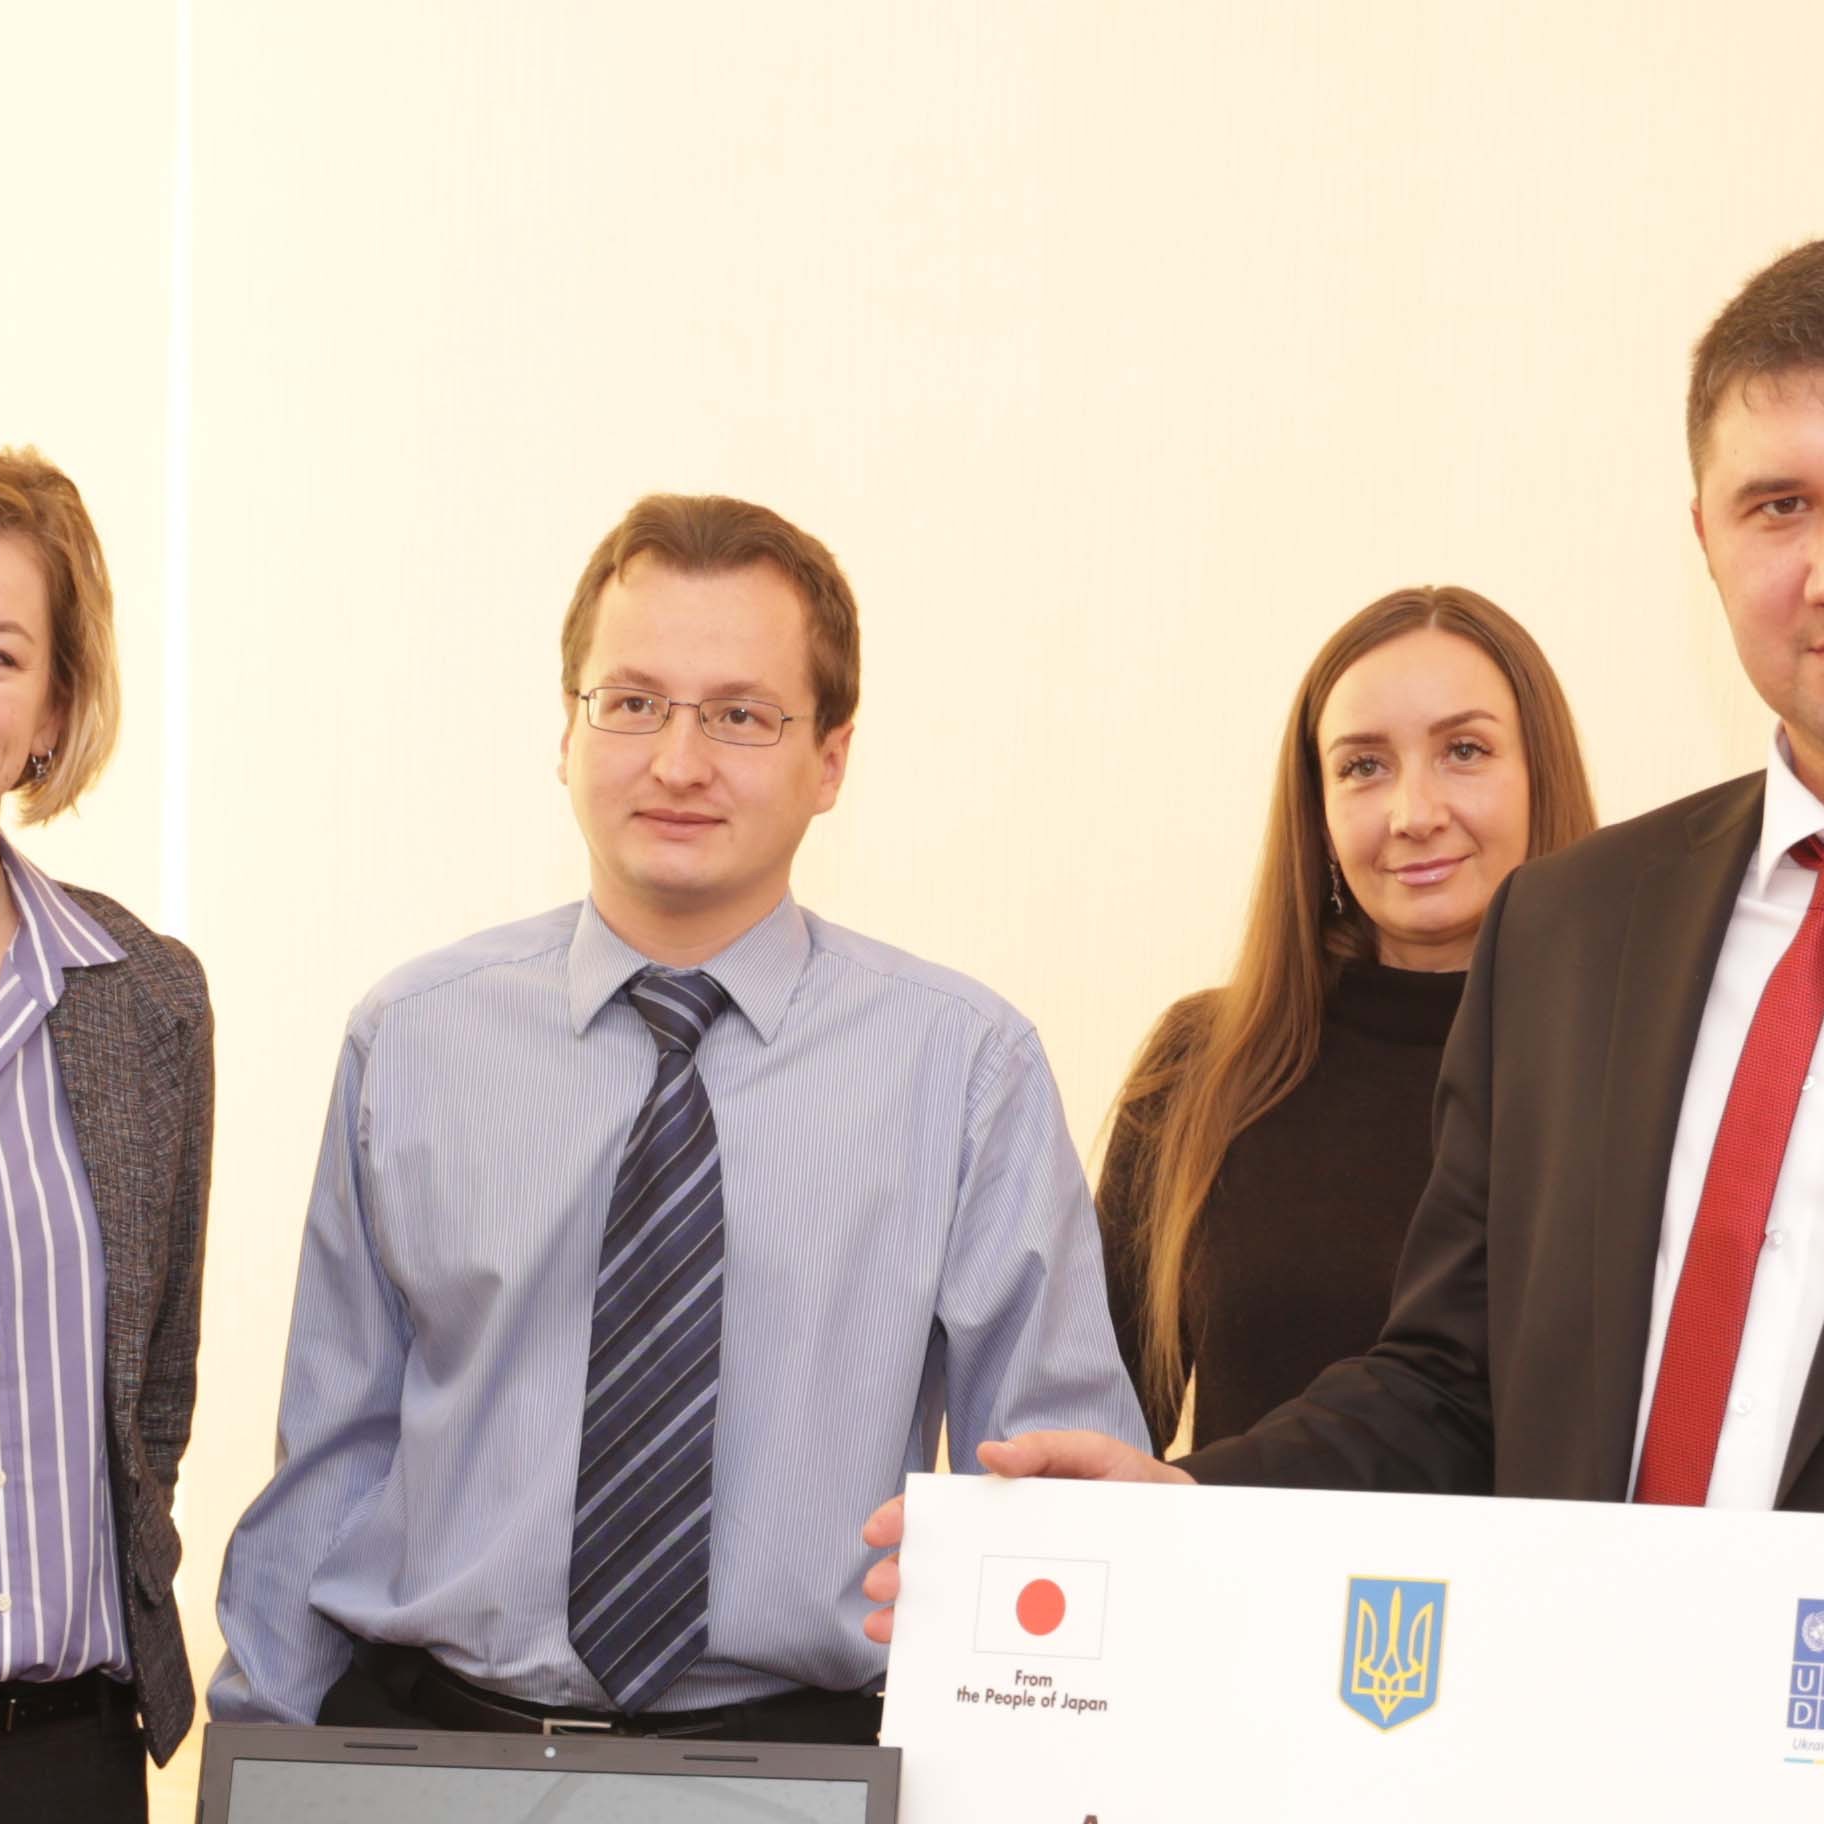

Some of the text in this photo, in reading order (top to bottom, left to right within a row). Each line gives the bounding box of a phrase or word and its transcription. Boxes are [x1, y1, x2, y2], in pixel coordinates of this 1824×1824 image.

[1014, 1669, 1053, 1687] From
[956, 1685, 1108, 1716] the People of Japan
